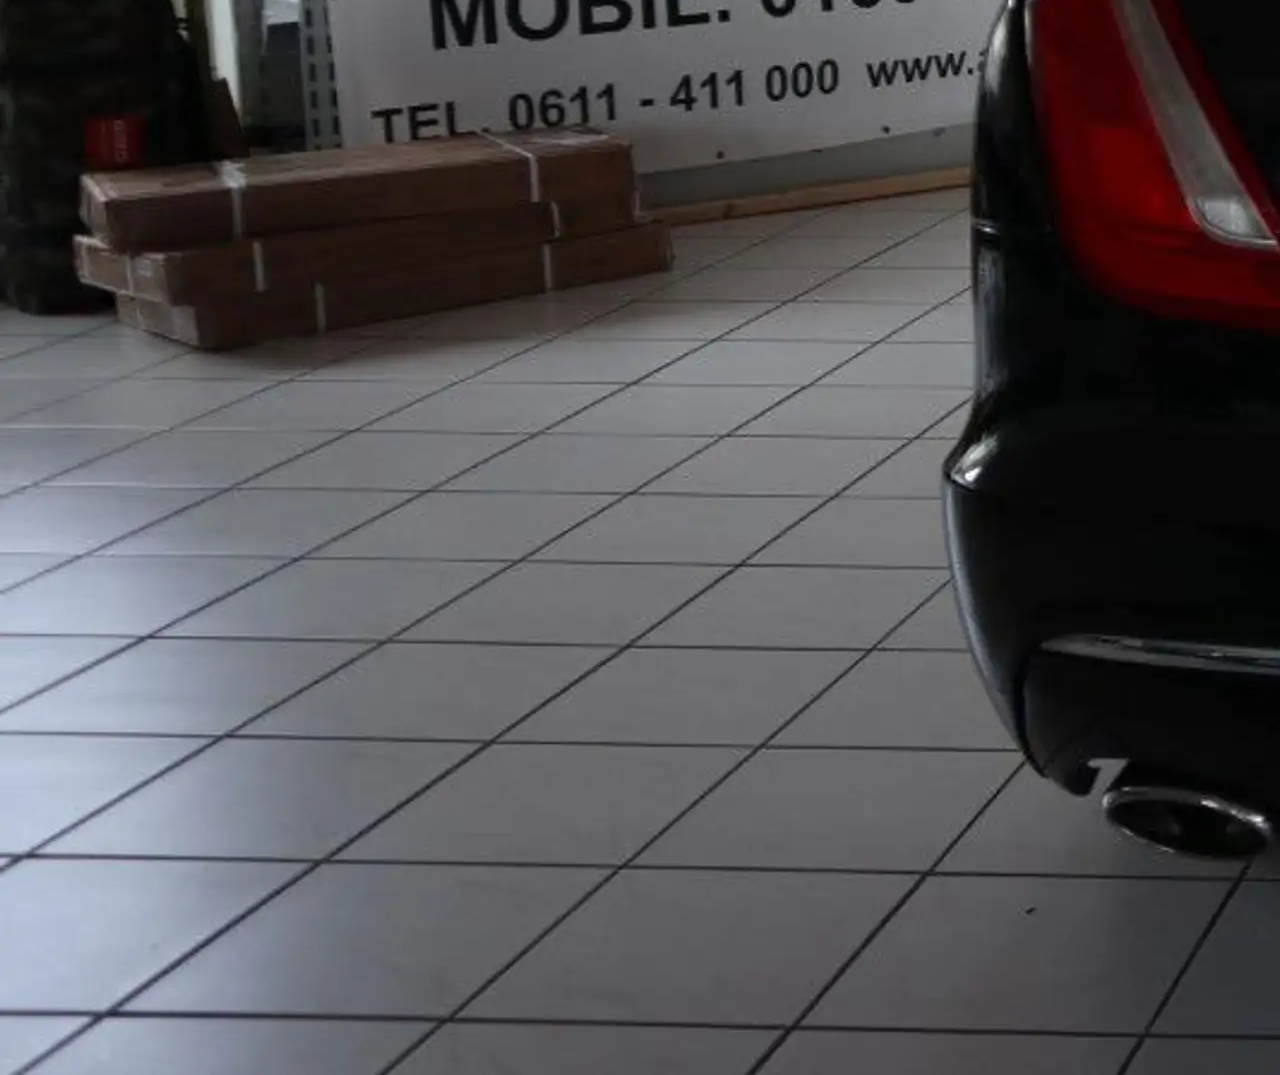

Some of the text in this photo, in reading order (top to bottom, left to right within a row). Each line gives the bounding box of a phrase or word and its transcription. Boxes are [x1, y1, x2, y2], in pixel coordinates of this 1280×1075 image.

[508, 83, 617, 131] 0611
[668, 69, 744, 112] 411
[764, 58, 840, 103] 000
